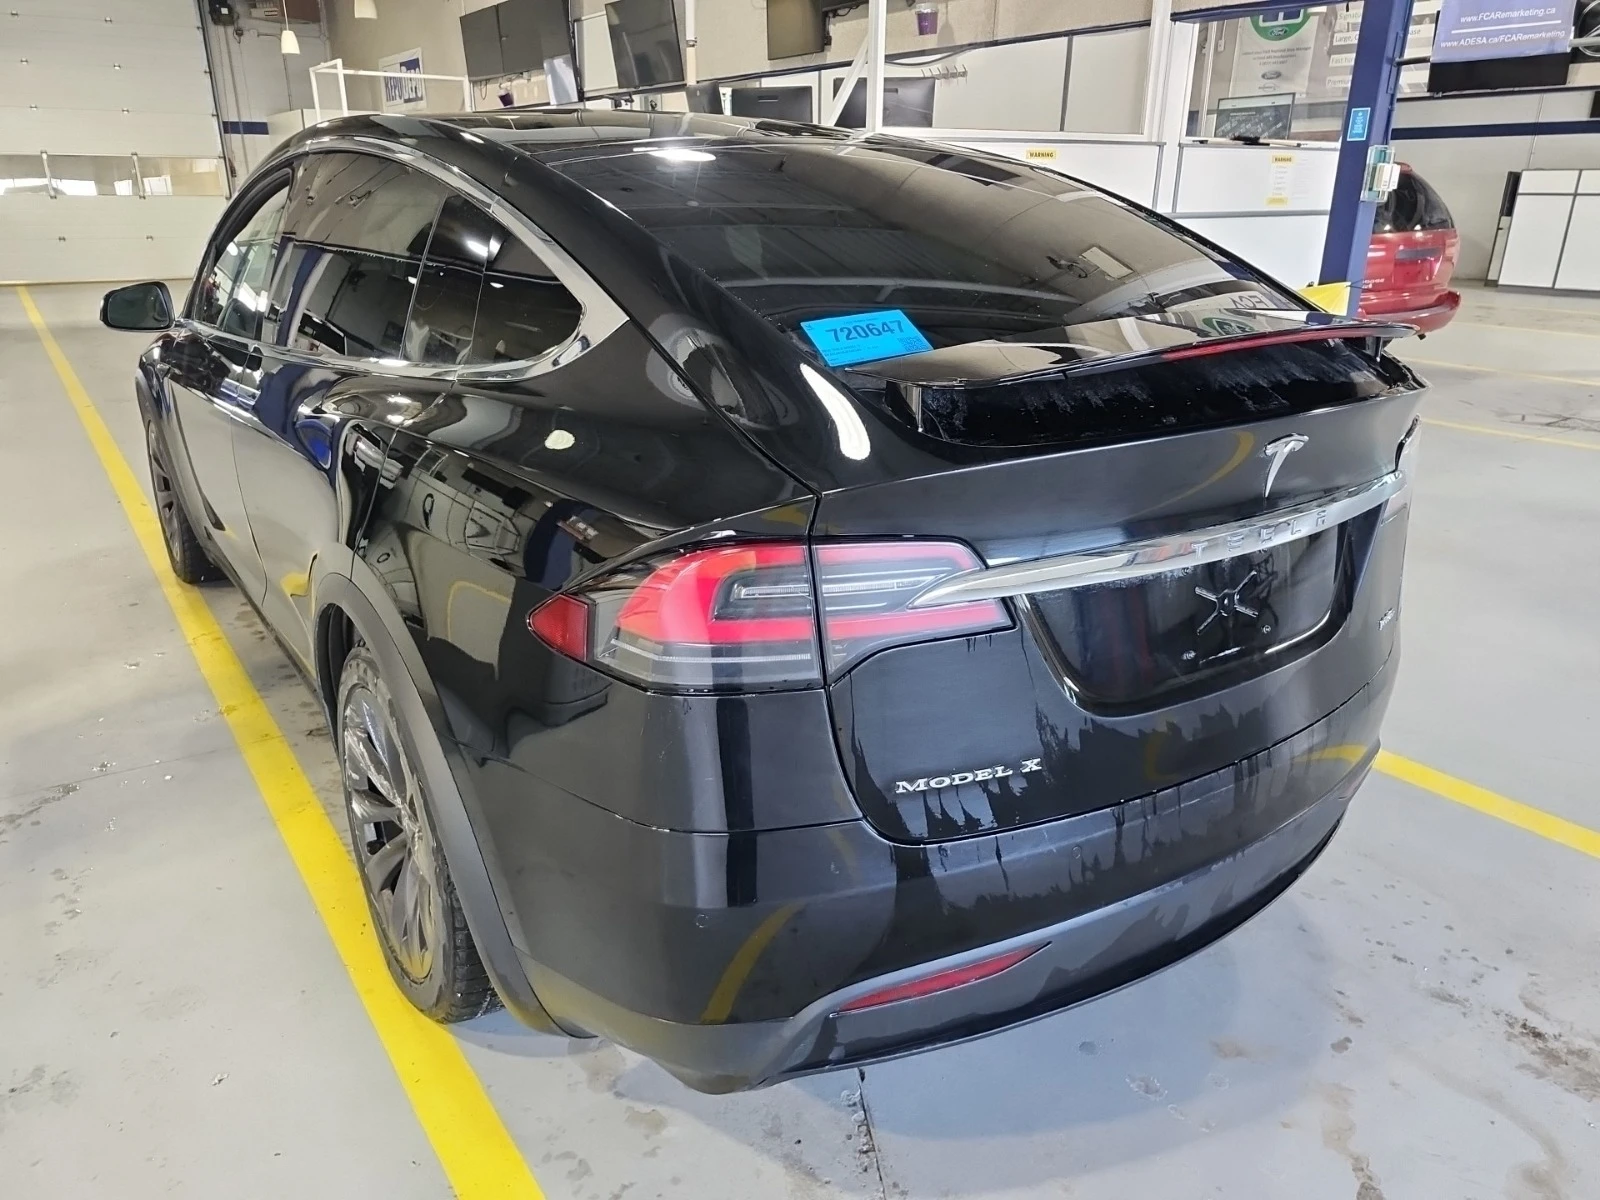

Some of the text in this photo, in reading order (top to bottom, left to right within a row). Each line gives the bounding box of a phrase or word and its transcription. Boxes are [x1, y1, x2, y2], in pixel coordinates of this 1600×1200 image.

[1460, 7, 1556, 23] www.FCARemarketing.ca
[1440, 30, 1565, 48] www.ADESA.ca/FCARemarketing
[825, 320, 904, 343] 720647
[1191, 509, 1328, 559] TESLA
[895, 758, 1042, 793] MODEL X
